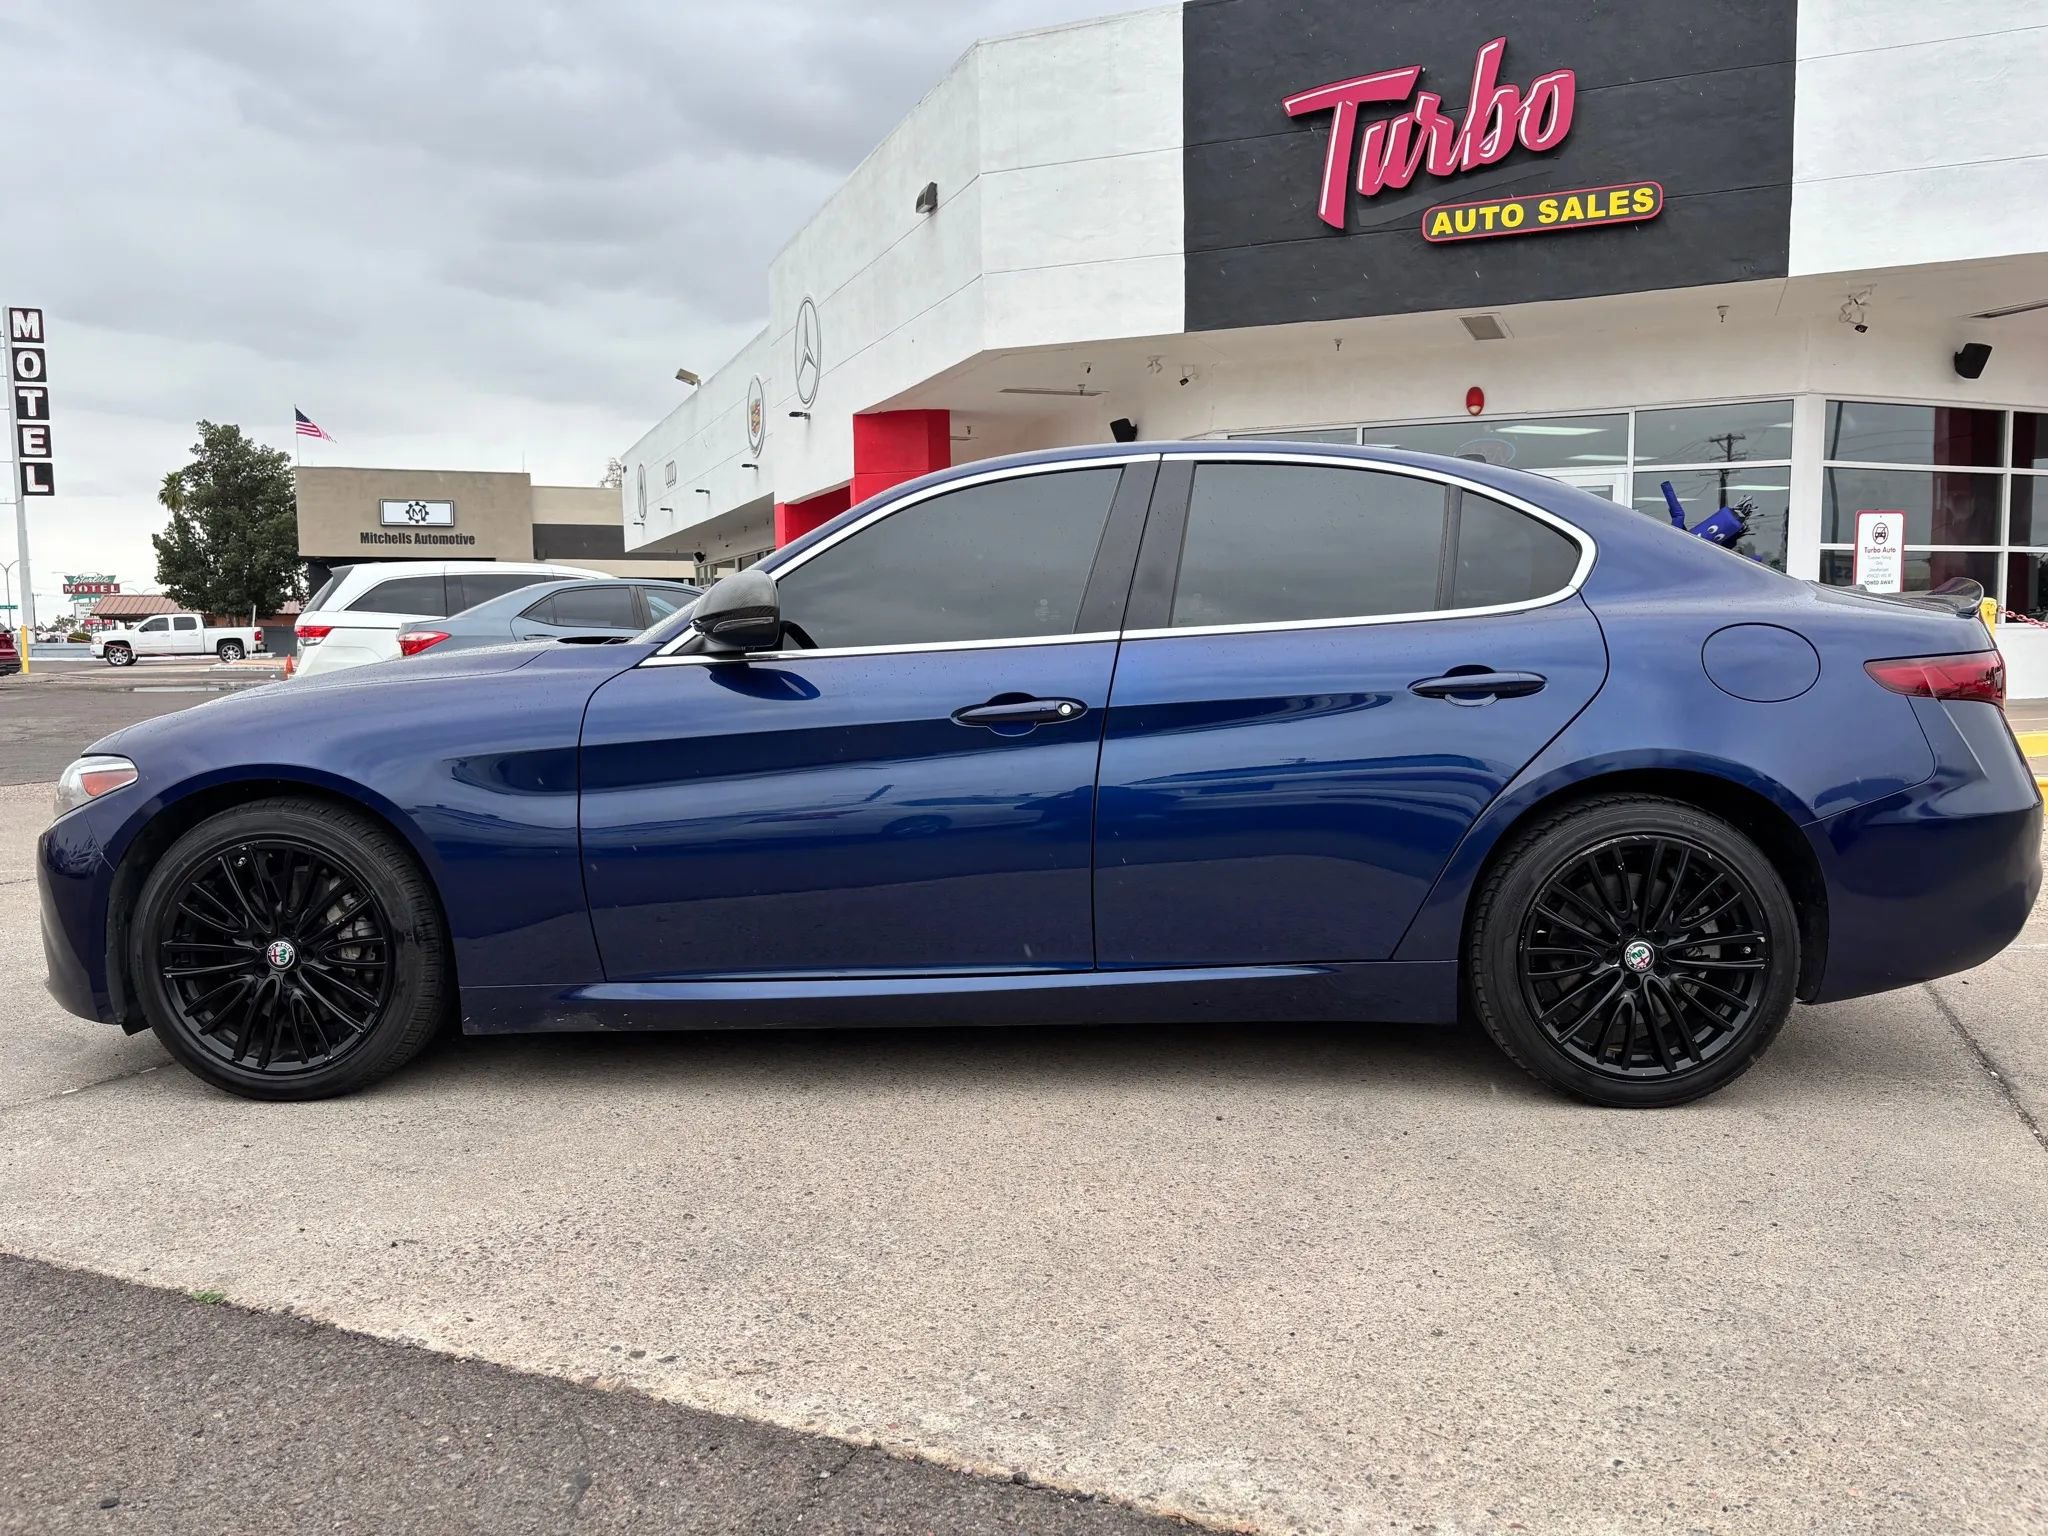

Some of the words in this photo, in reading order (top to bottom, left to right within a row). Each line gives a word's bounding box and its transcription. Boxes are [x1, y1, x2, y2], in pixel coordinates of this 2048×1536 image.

[1282, 36, 1576, 230] Turbo
[1430, 203, 1525, 237] AUTO
[1538, 187, 1654, 224] SALES
[12, 310, 49, 493] MOTEL
[360, 532, 412, 545] Mitchells
[414, 533, 475, 545] Automotive
[64, 585, 119, 593] MOTEL
